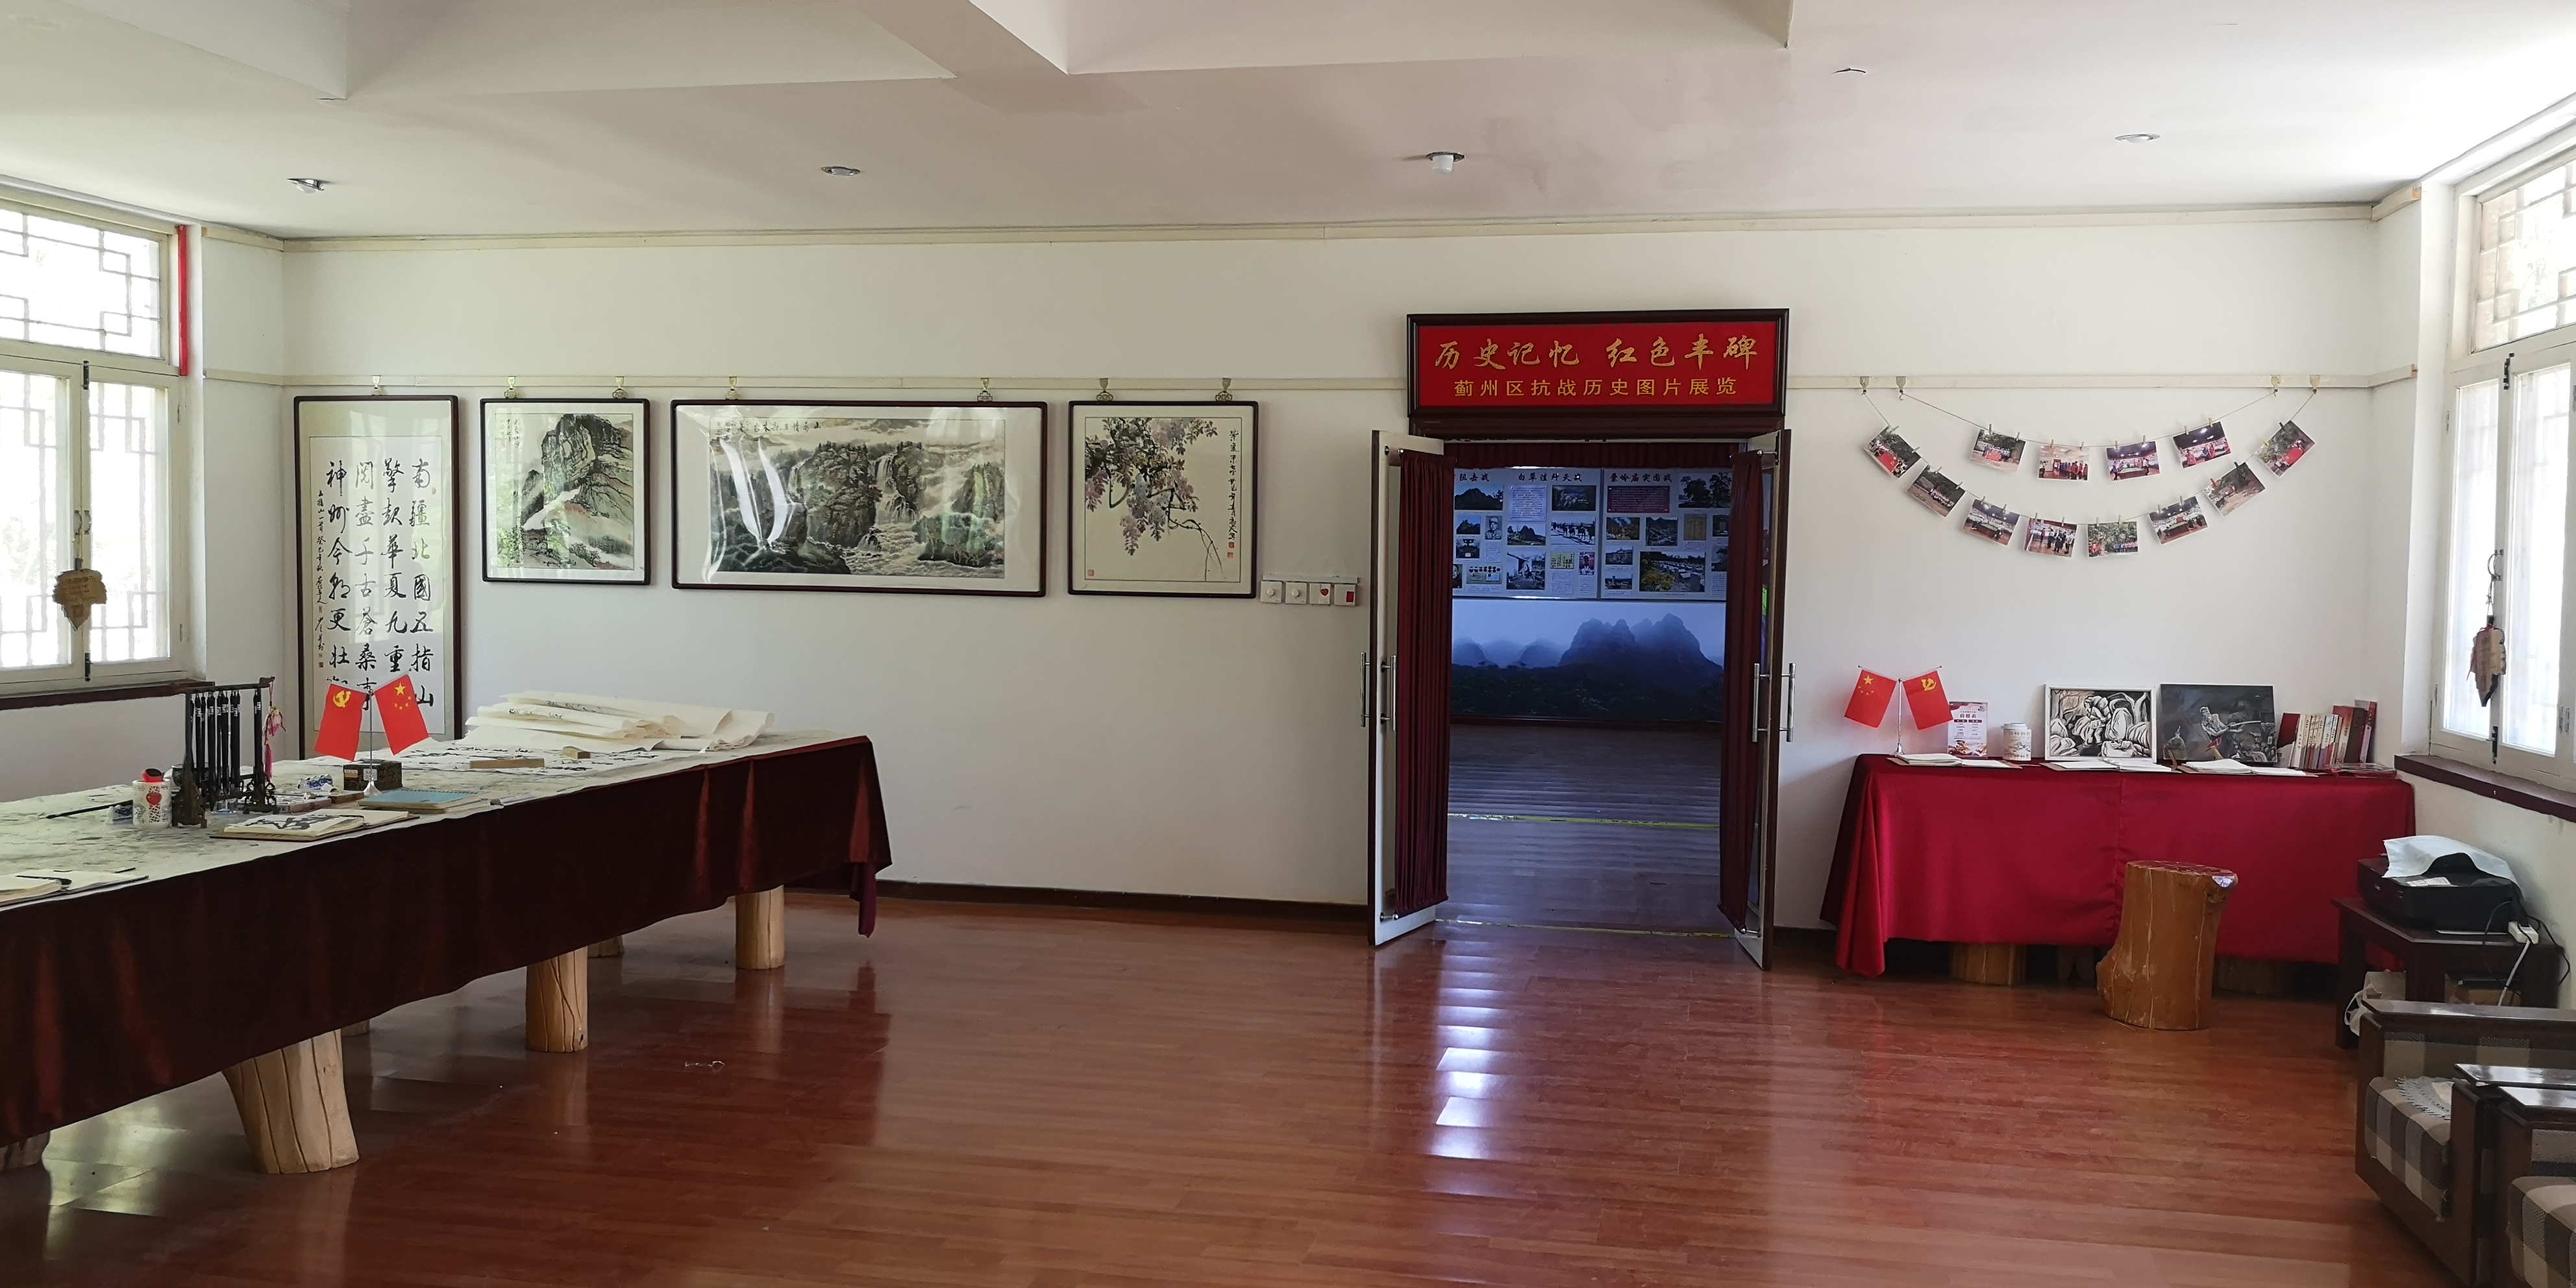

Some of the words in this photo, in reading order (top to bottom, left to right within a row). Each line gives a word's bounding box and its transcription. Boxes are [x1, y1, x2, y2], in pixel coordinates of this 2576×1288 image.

[1434, 338, 1579, 369] 历史记忆
[1605, 333, 1757, 370] 红色丰碑
[1454, 377, 1737, 397] 蓟州区抗战历史图片展览
[1459, 472, 1490, 482] 阻击战
